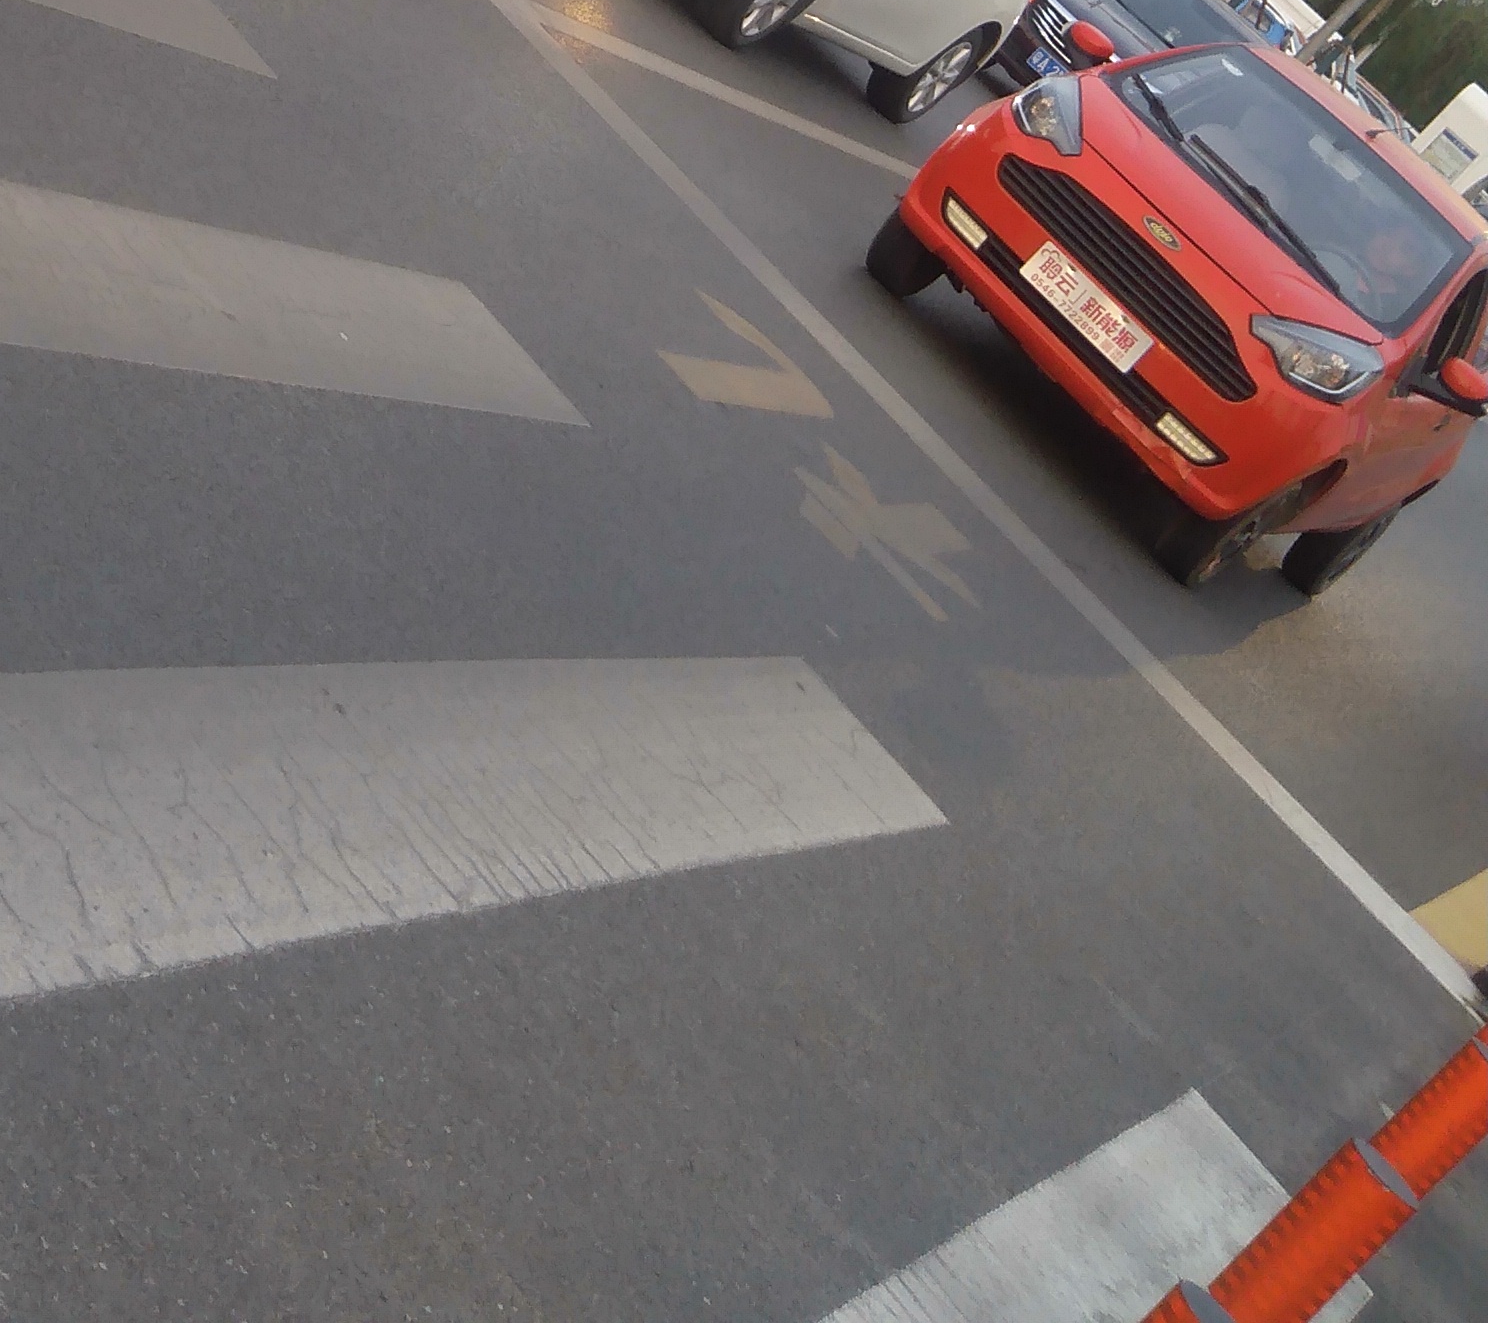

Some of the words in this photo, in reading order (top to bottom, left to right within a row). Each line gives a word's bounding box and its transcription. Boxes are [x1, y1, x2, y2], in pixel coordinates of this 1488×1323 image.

[1029, 271, 1100, 342] 0546-7722899
[1078, 294, 1138, 354] 新能源
